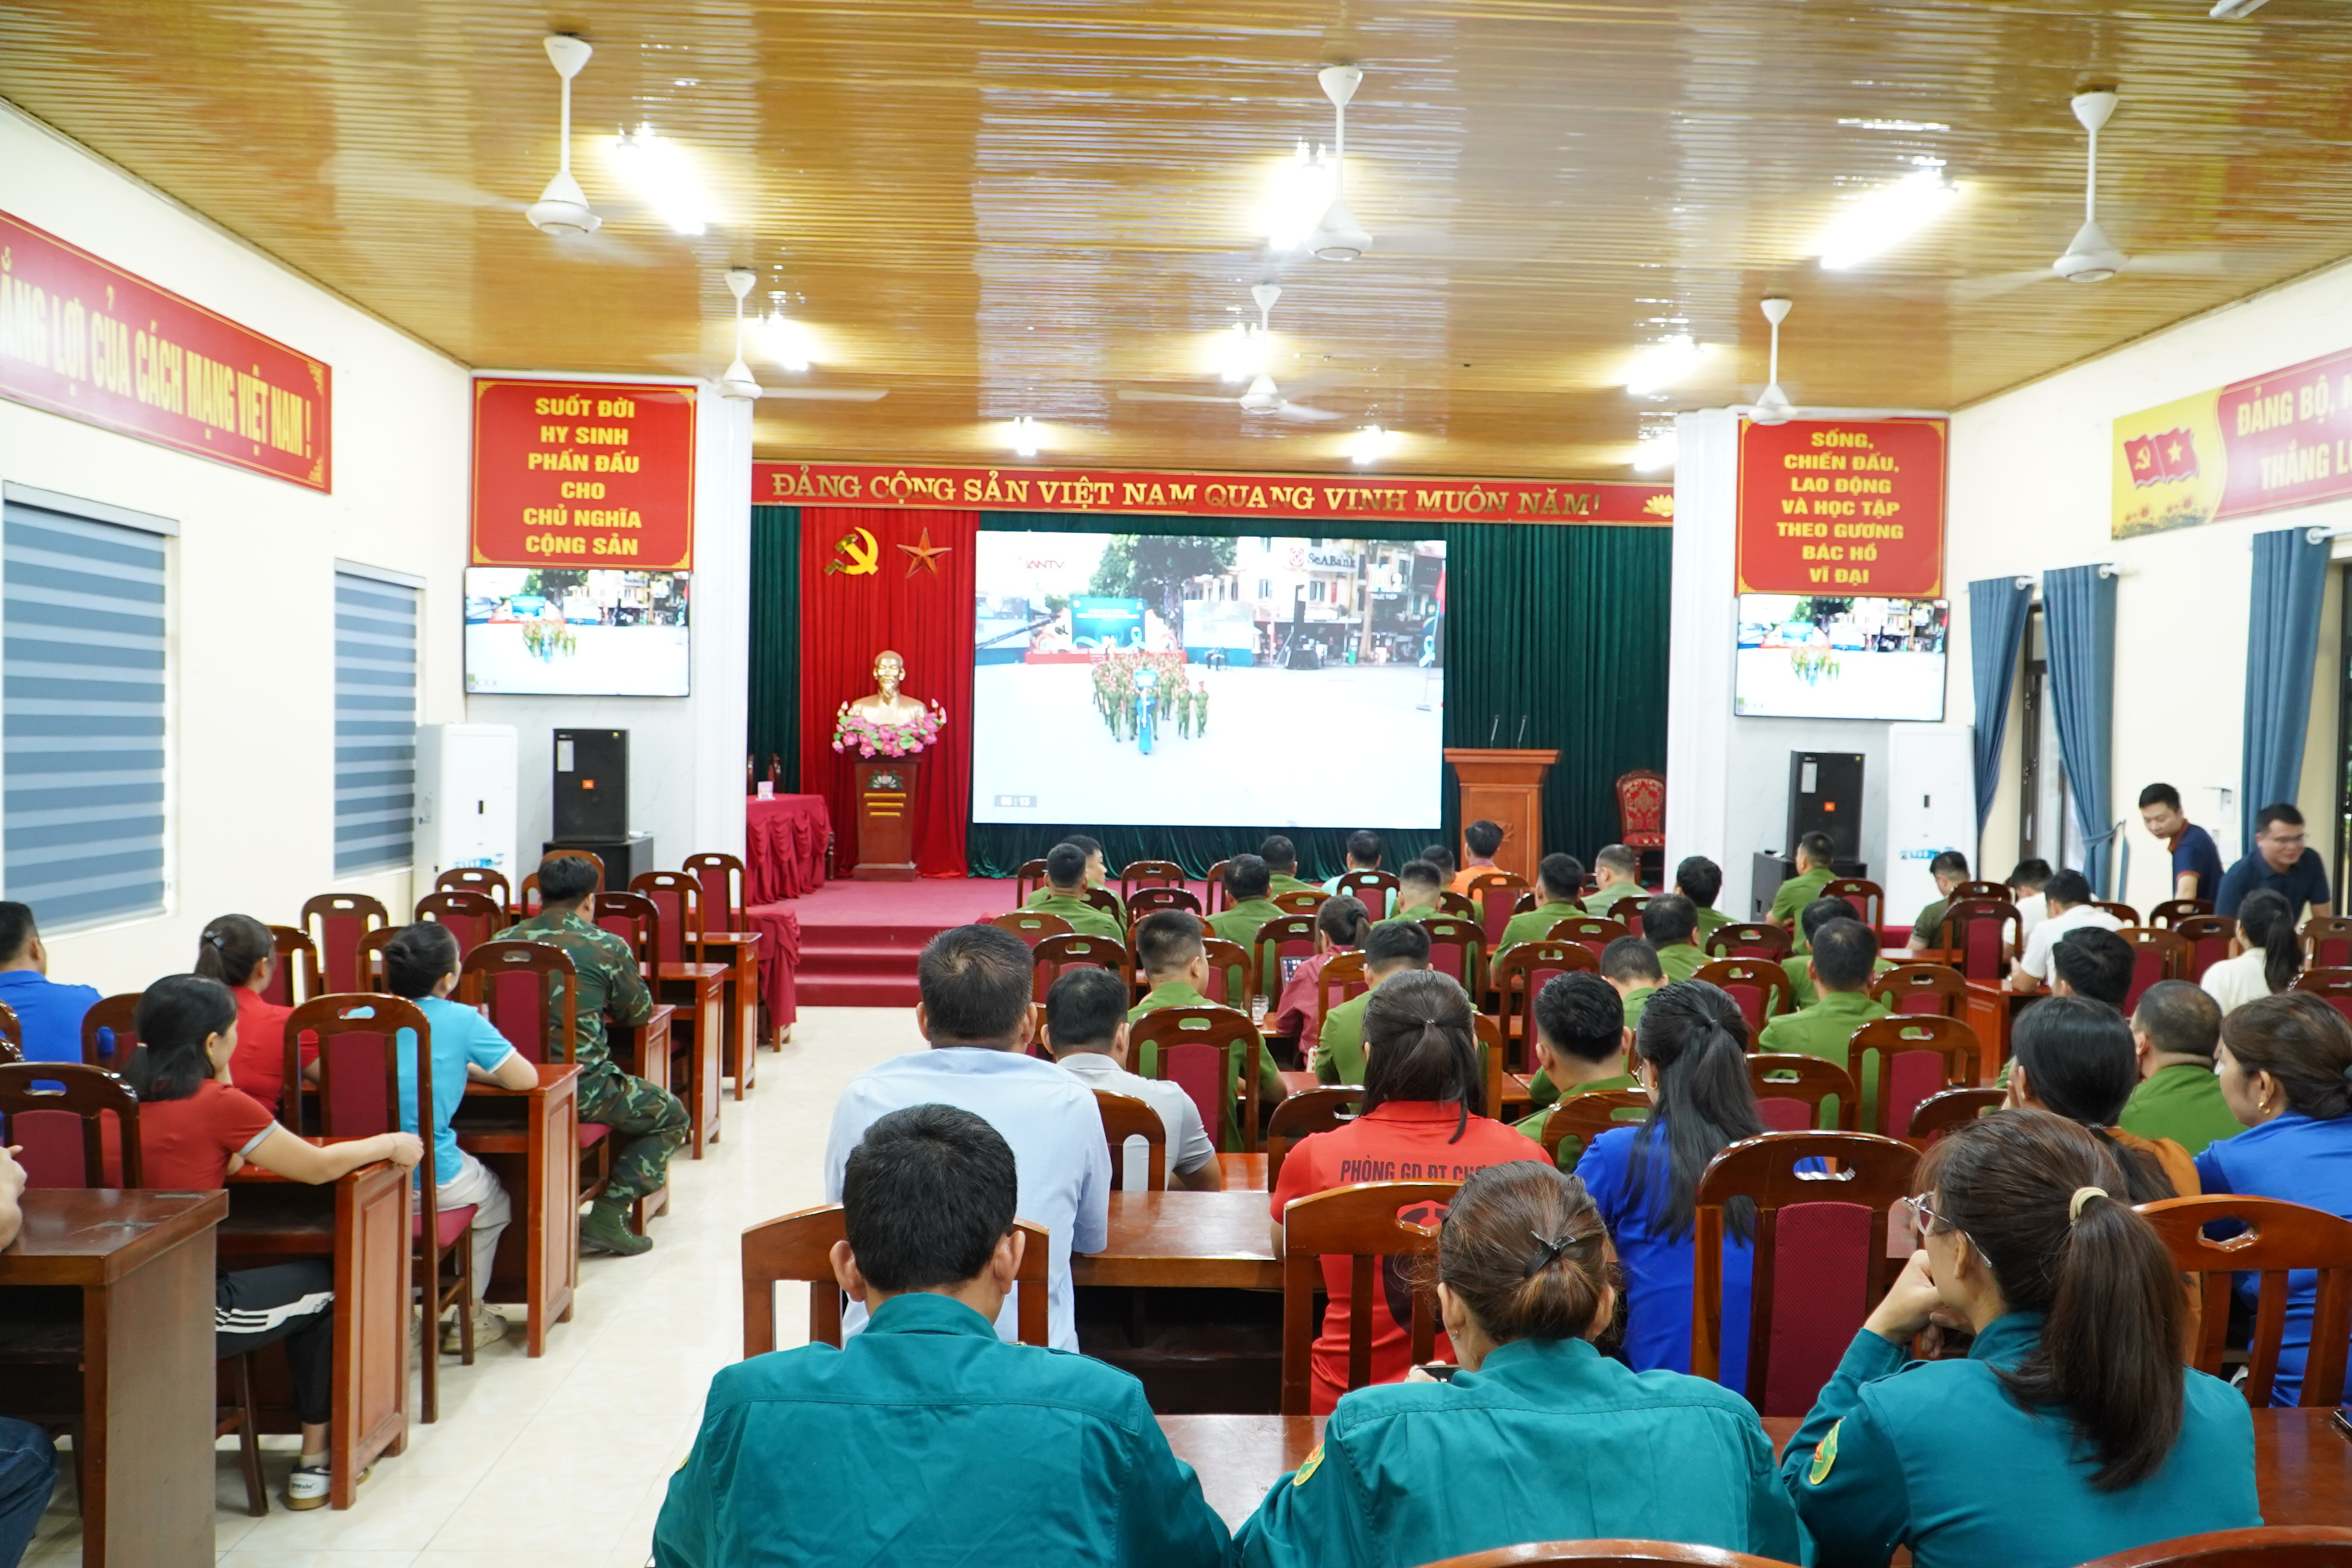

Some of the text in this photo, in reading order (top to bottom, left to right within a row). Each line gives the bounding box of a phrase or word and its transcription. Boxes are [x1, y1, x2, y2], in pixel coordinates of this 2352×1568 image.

[52, 294, 86, 397] LỢI
[91, 284, 131, 397] CỦA
[135, 320, 183, 415] CÁCH
[186, 349, 235, 440] MẠNG
[237, 363, 268, 456] VIỆT
[535, 393, 635, 418] SUỐT ĐỜI
[2237, 385, 2293, 437] ĐẢNG
[2300, 373, 2335, 424] BỘ,
[540, 425, 628, 445] HY SINH
[1811, 428, 1874, 449] SỐNG,
[528, 448, 639, 473] PHẤN ĐẤU
[1784, 451, 1900, 473] CHIẾN ĐẤU,
[2261, 439, 2330, 491] THẮNG
[561, 481, 605, 500] CHO
[771, 464, 1601, 515] ĐẢNG CỘNG SẢN VIỆT NAM QUANG VINH MUÔN NĂM!
[1791, 476, 1892, 496] LAO ĐỘNG
[523, 504, 642, 528] CHỦ NGHĨA
[1781, 497, 1900, 519] VÀ HỌC TẬP
[1777, 522, 1904, 540] THEO GƯƠNG
[525, 532, 638, 556] CỘNG SẢN
[1802, 542, 1843, 561] BÁC
[1026, 560, 1065, 569] ANTV
[1307, 553, 1356, 568] SeABank
[1809, 565, 1869, 586] VĨ ĐẠI
[1340, 1154, 1395, 1182] PHÒNG
